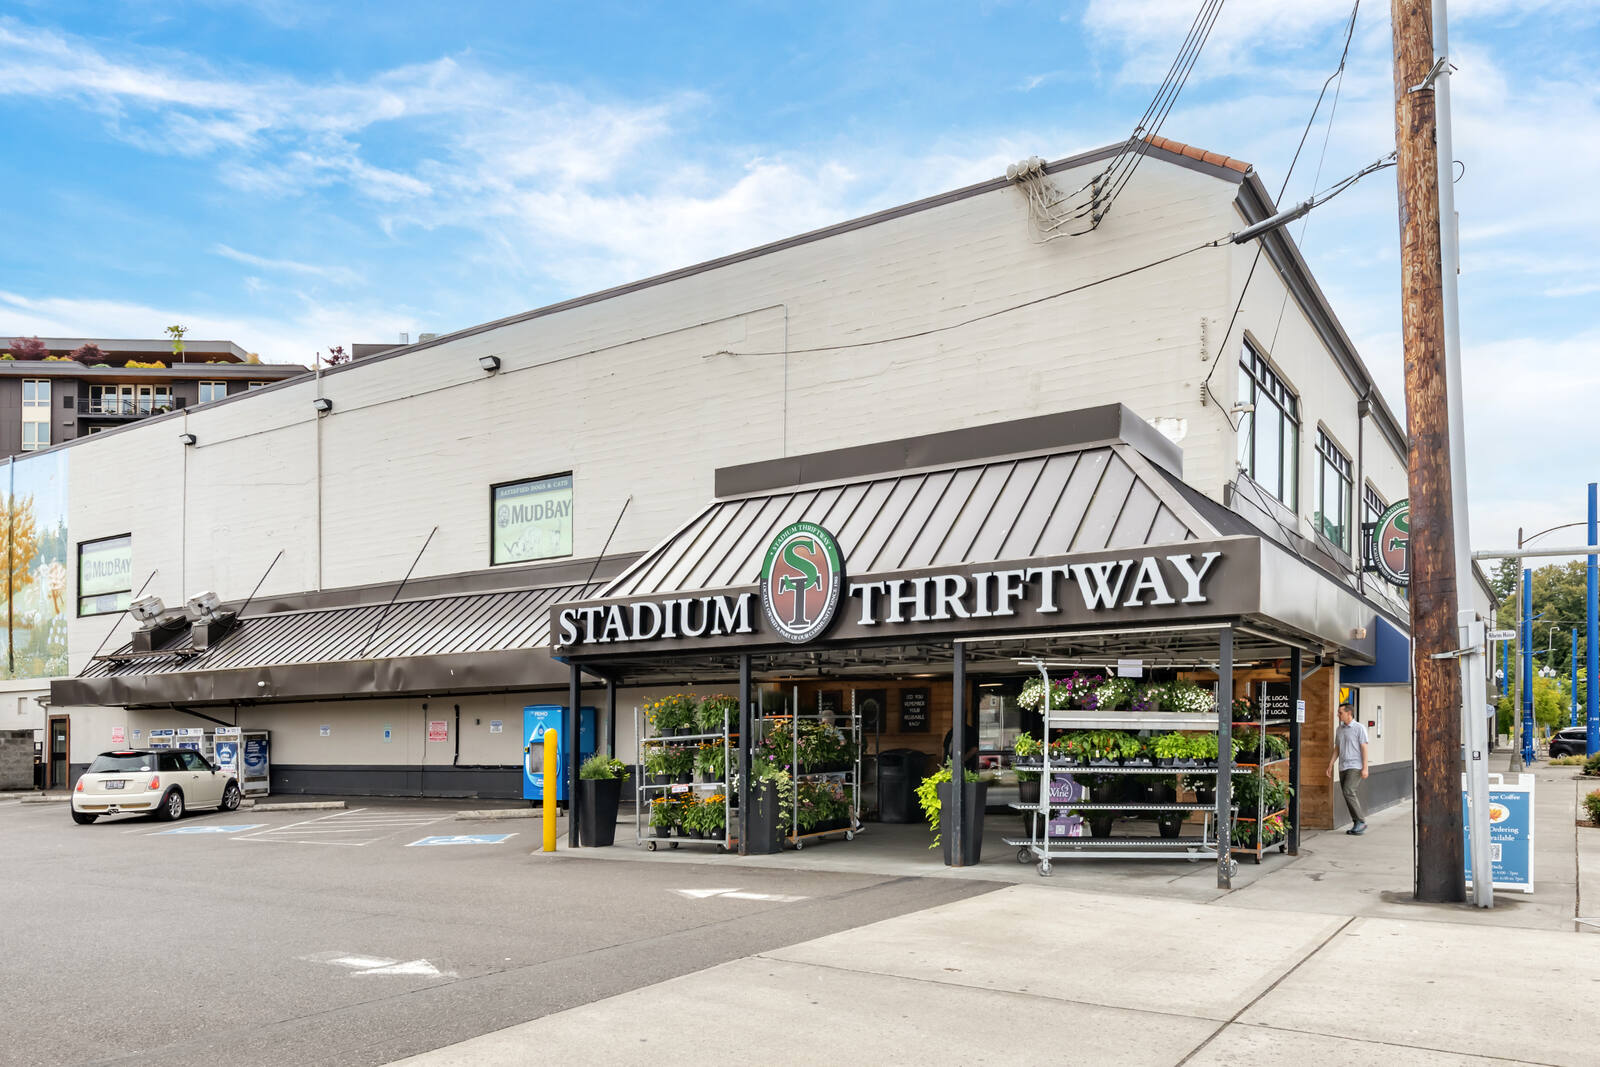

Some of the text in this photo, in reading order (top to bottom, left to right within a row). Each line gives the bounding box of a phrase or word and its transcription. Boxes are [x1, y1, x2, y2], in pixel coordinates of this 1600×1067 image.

[553, 479, 568, 488] CATS
[773, 524, 830, 550] STADIUM THRIFTWAY
[559, 551, 1222, 646] STADIUM THRIFTWAY
[1049, 787, 1069, 798] Wine
[1490, 826, 1519, 834] Ordering
